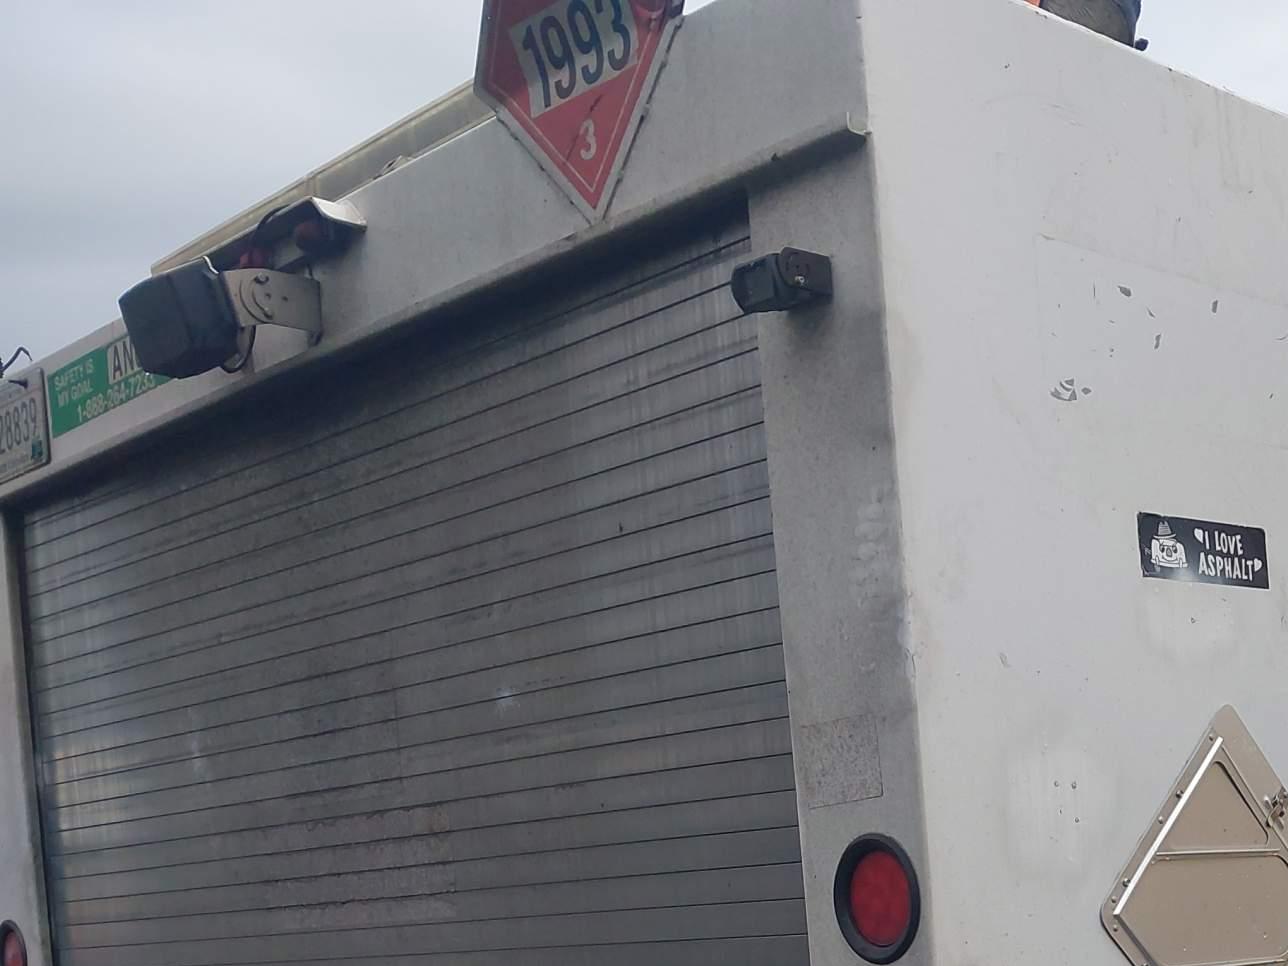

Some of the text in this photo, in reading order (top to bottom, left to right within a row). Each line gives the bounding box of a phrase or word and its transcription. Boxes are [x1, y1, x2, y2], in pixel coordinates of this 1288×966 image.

[521, 0, 631, 108] 1993
[579, 118, 597, 160] 3
[112, 340, 136, 380] AN
[1204, 530, 1244, 555] I LOVE
[1198, 552, 1254, 581] ASPHALT
